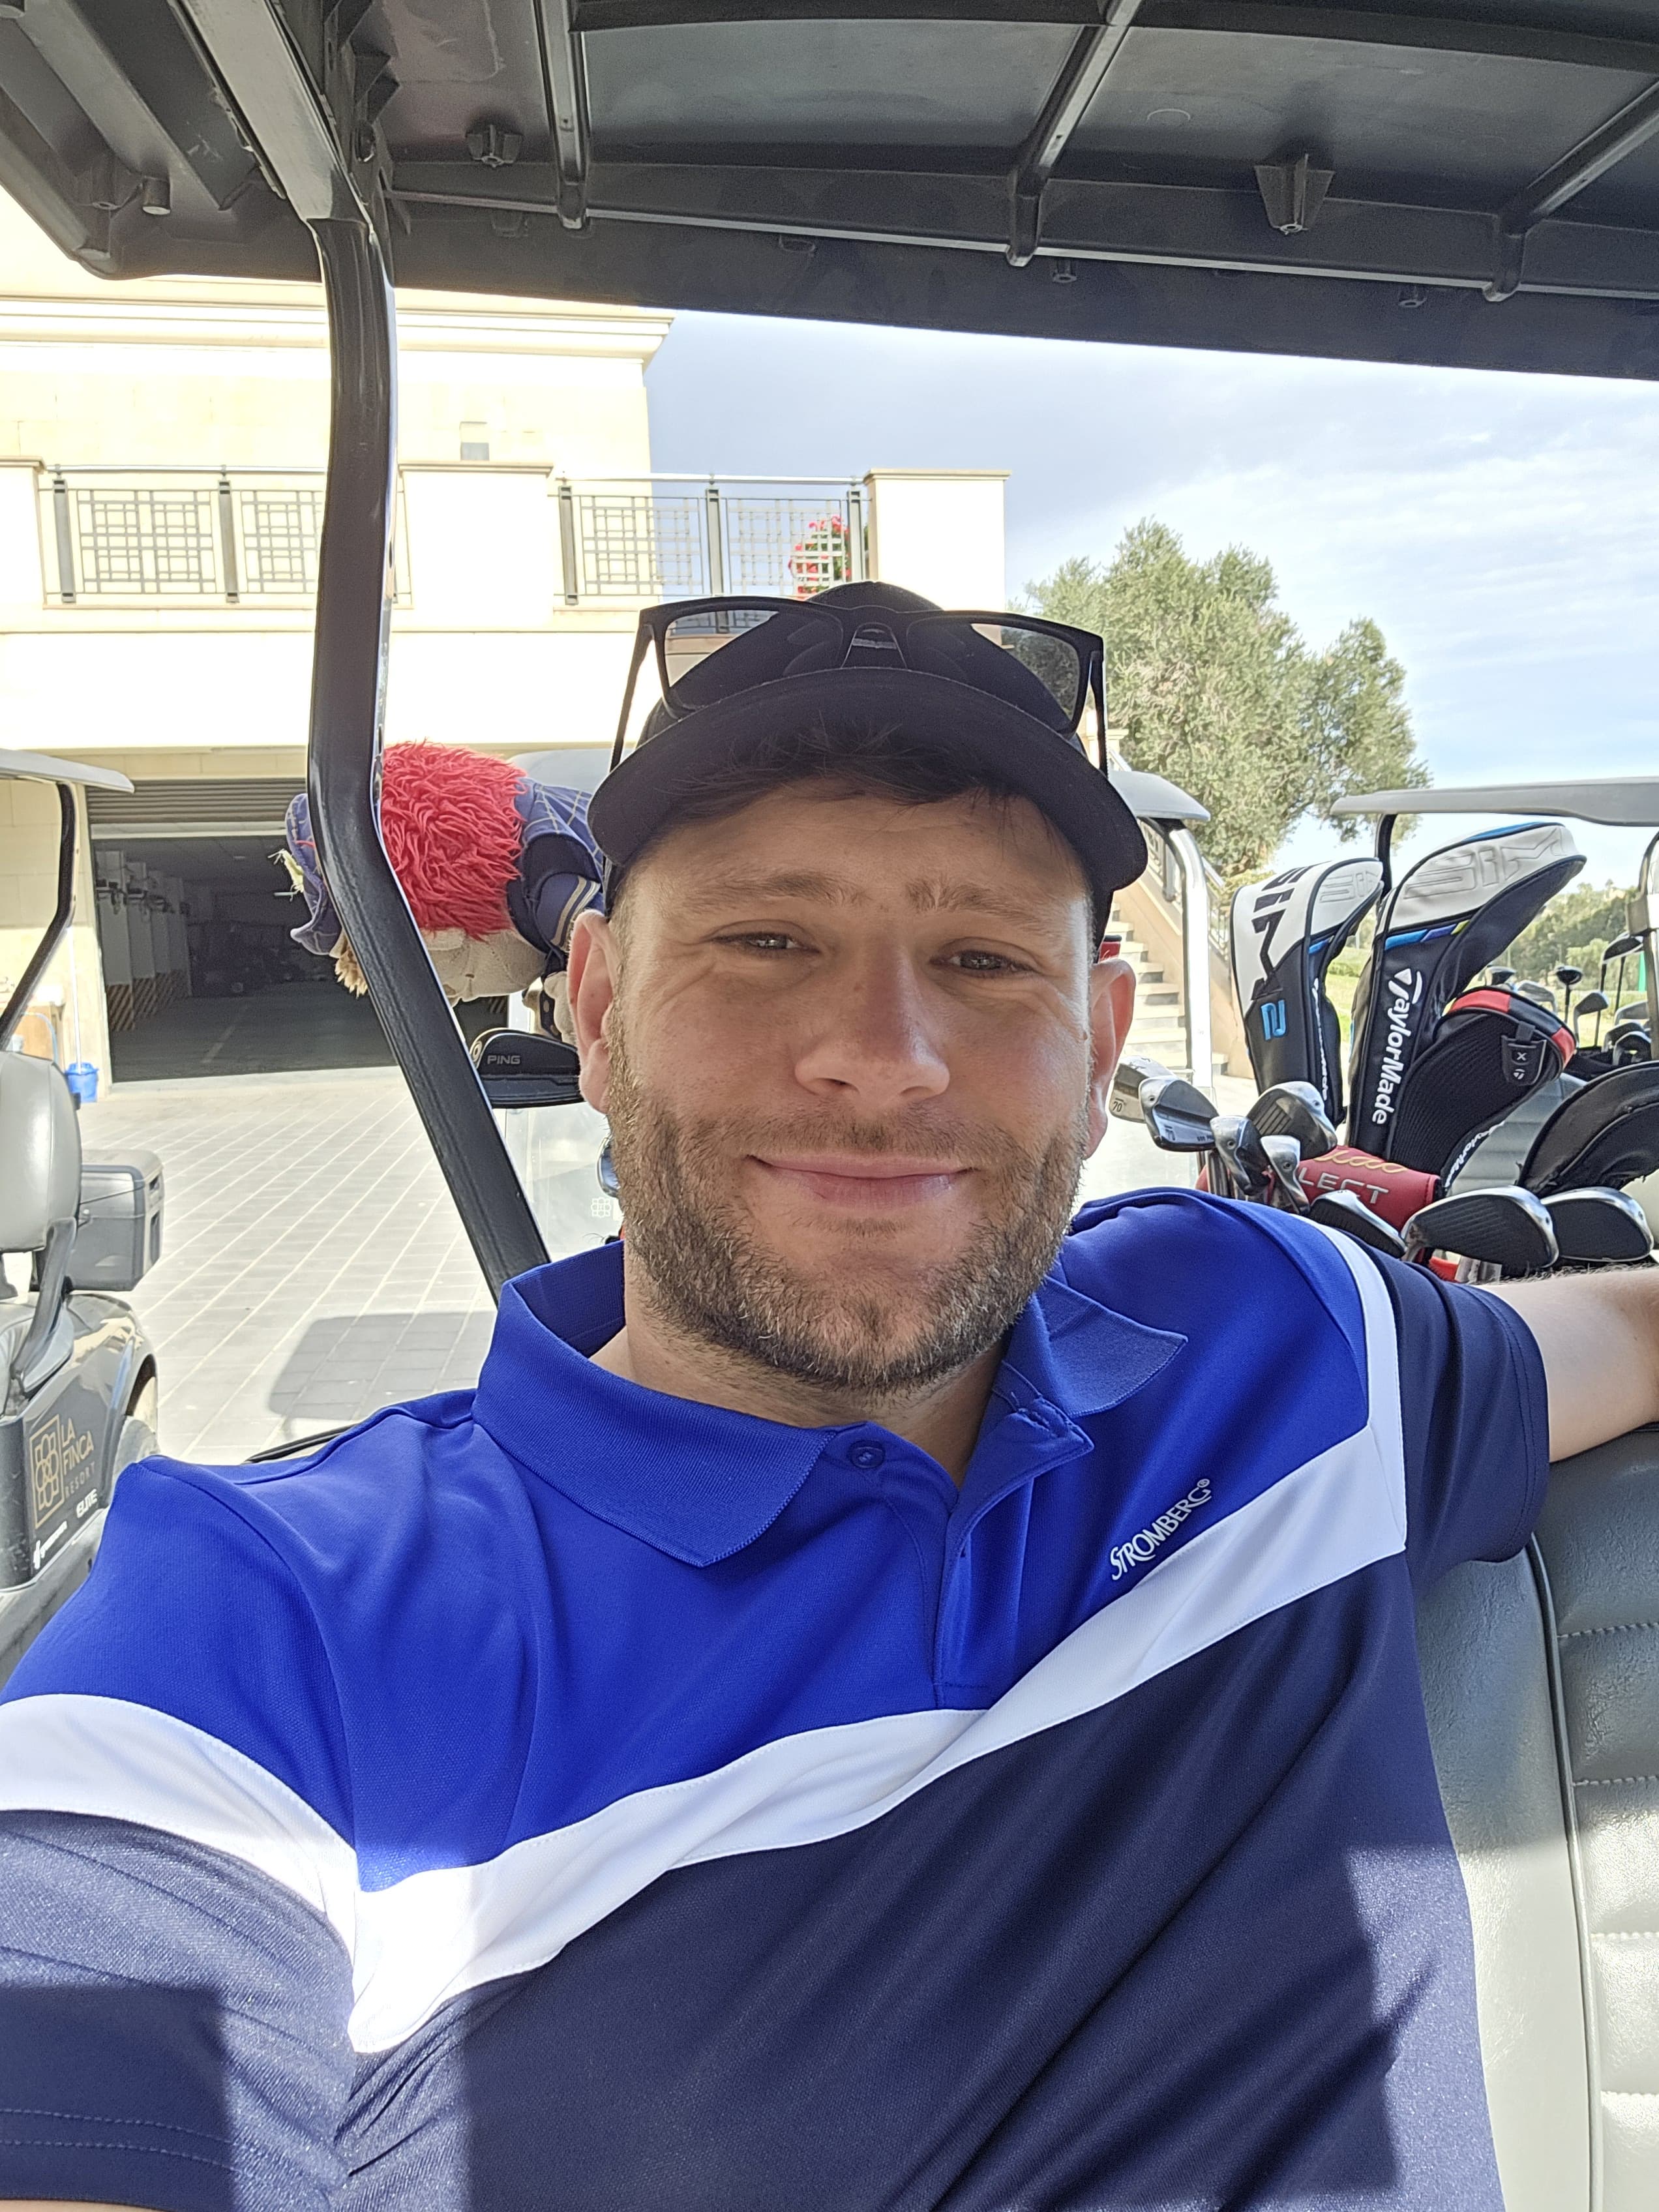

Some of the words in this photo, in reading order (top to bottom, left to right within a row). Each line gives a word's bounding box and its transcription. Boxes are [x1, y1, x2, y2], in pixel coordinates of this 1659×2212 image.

[487, 1055, 521, 1065] PING
[1372, 968, 1423, 1125] TaylorMade
[1298, 1167, 1389, 1204] LECT
[61, 1418, 76, 1448] LA
[63, 1430, 95, 1476] FINCA
[65, 1461, 96, 1499] RESORT
[76, 1489, 97, 1519] ELITE
